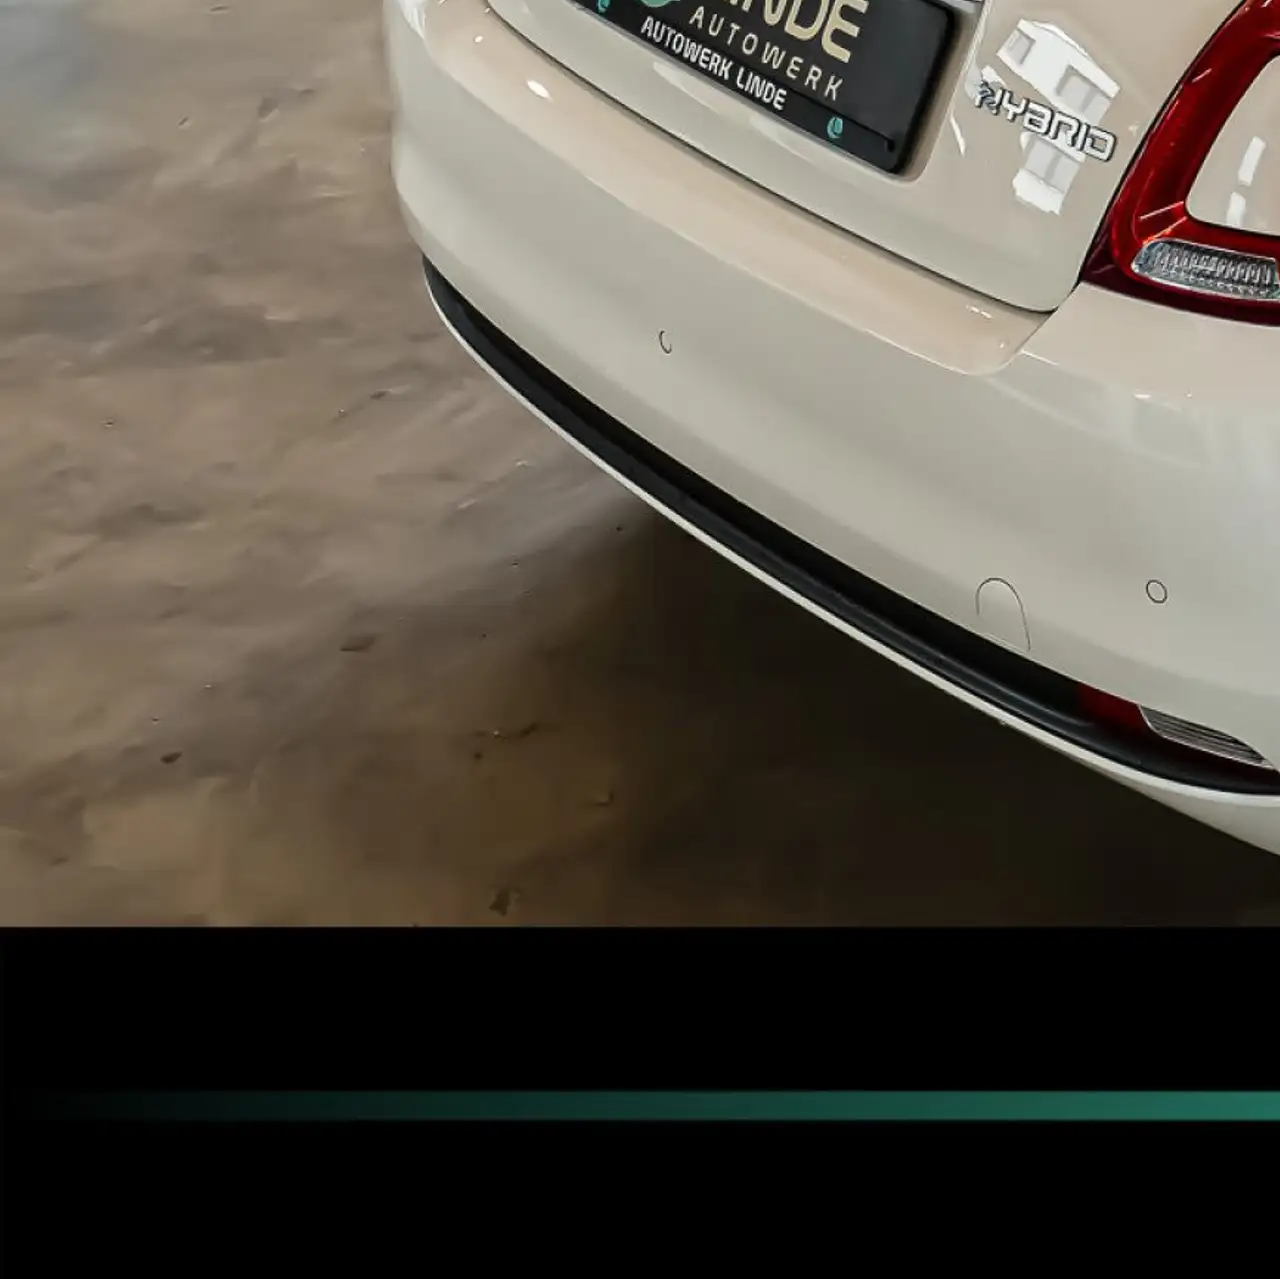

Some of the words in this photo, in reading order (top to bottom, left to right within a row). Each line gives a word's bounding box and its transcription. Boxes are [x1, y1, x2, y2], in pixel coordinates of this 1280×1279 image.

[640, 16, 734, 81] AUTOWERK
[735, 66, 788, 111] LINDE
[688, 5, 844, 101] AUTOWERK
[974, 80, 1117, 163] HYBRID
